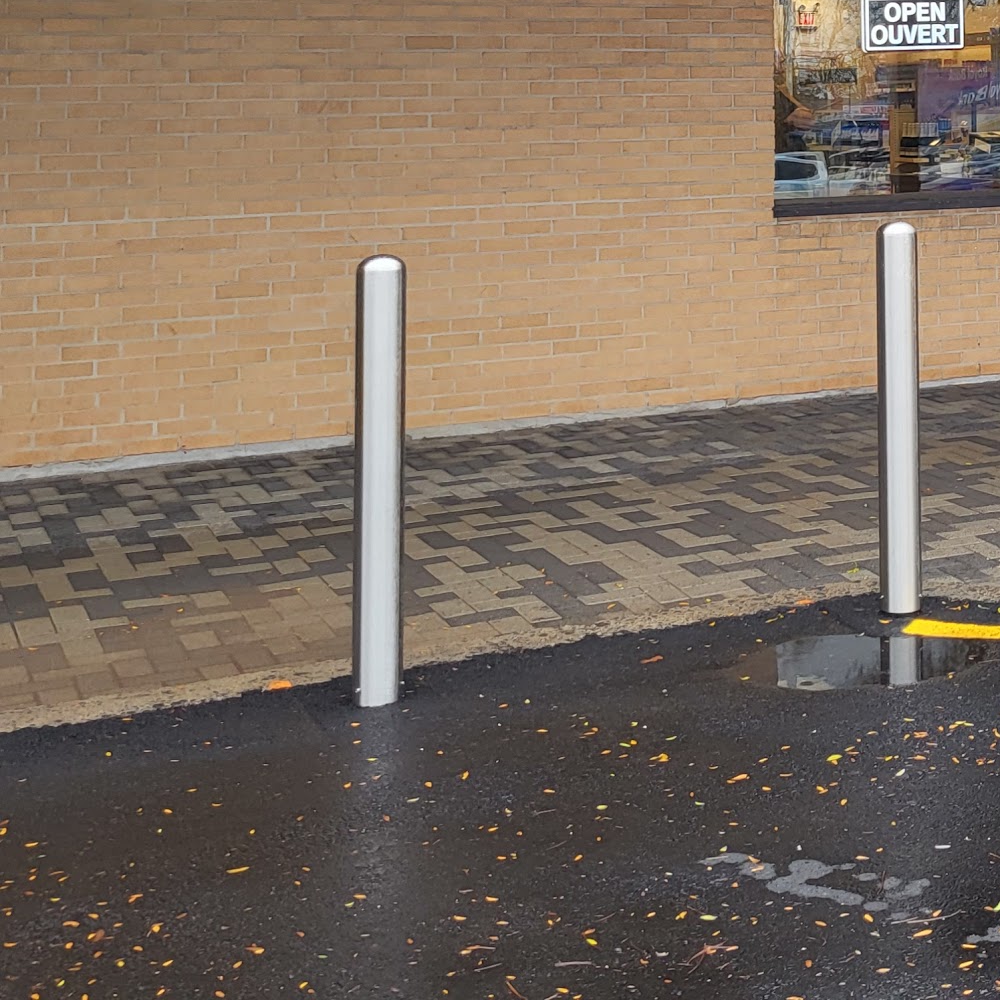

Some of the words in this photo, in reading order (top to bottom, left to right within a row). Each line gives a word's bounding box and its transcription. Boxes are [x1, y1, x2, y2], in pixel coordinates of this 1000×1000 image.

[798, 12, 815, 25] EXIT
[883, 1, 946, 23] OPEN
[870, 23, 959, 46] OUVERT
